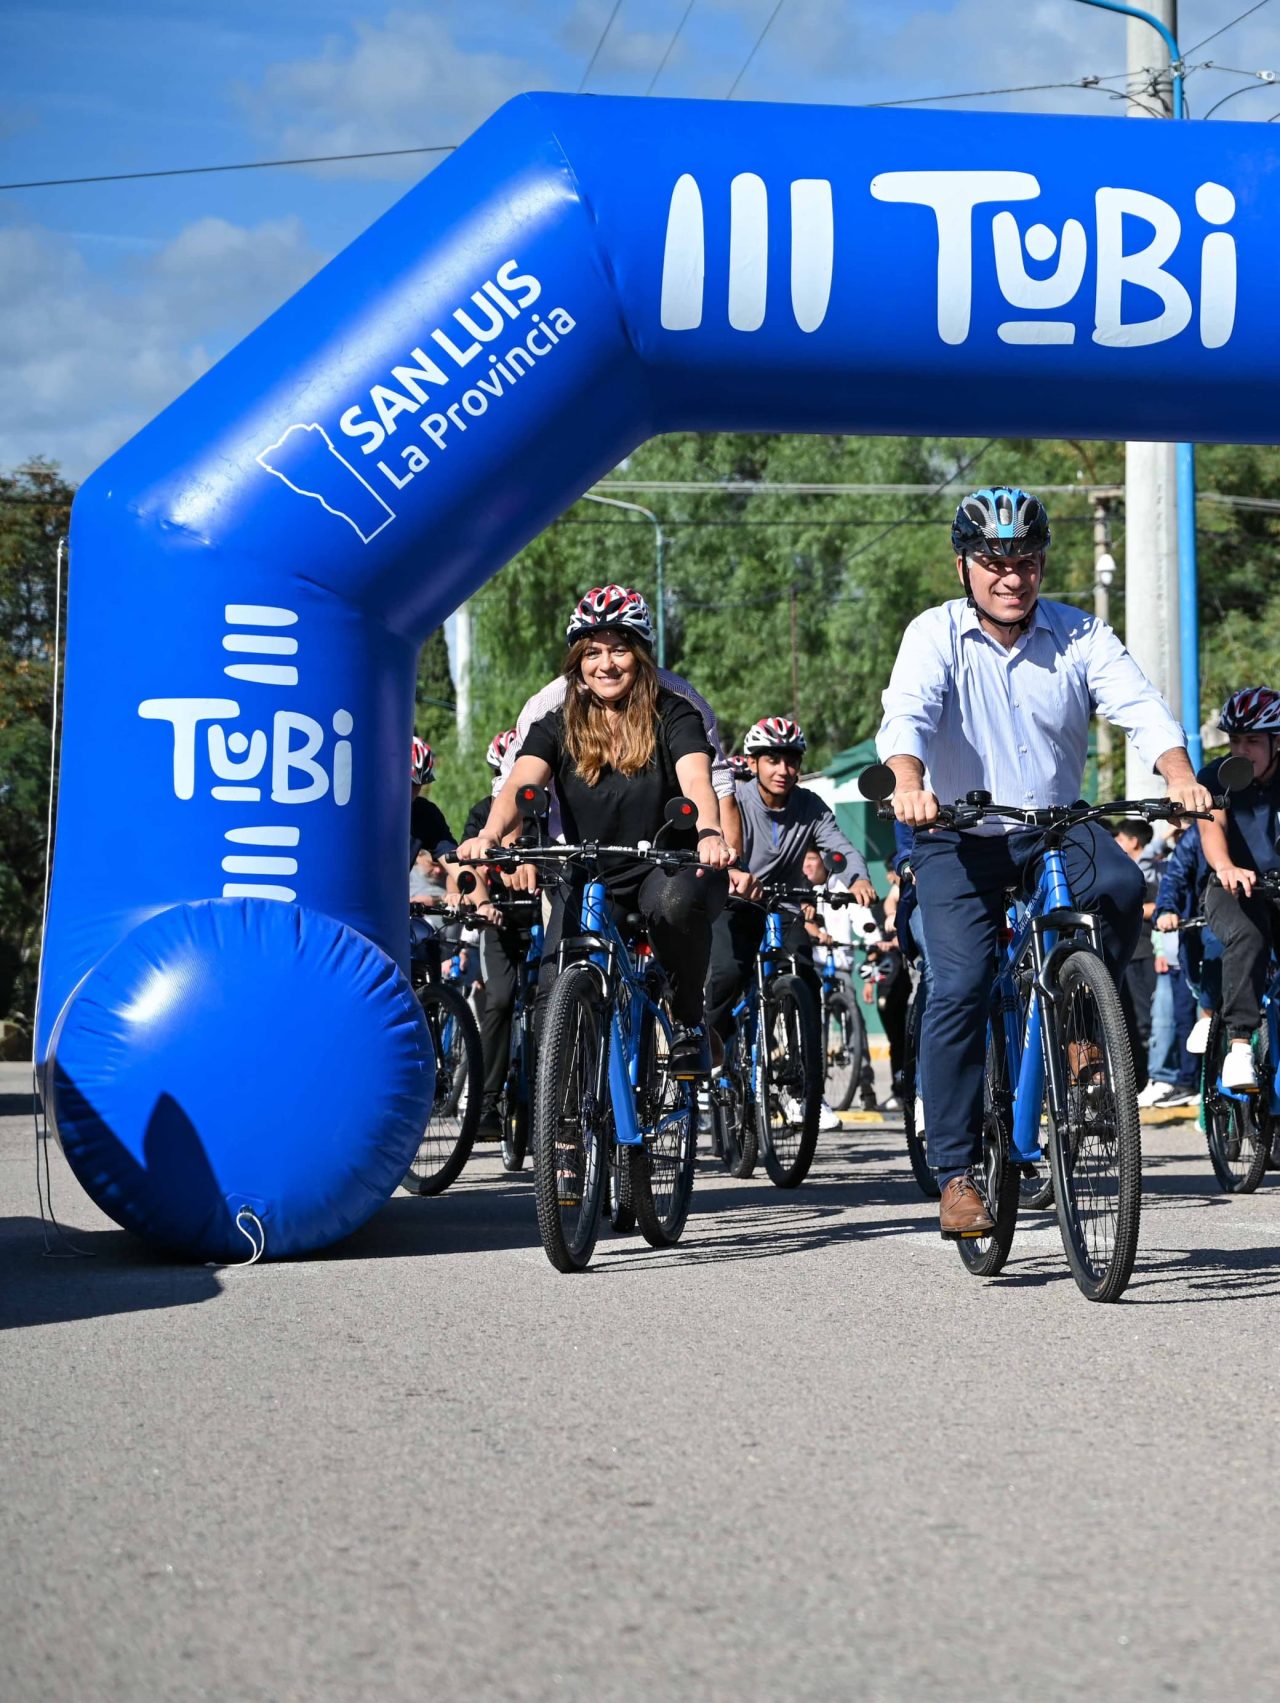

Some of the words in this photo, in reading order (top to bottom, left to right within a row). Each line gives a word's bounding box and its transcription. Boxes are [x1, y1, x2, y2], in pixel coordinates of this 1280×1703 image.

[339, 347, 450, 456] SAN
[430, 258, 542, 368] LUIS
[376, 444, 431, 490] La
[419, 306, 577, 450] Provincia
